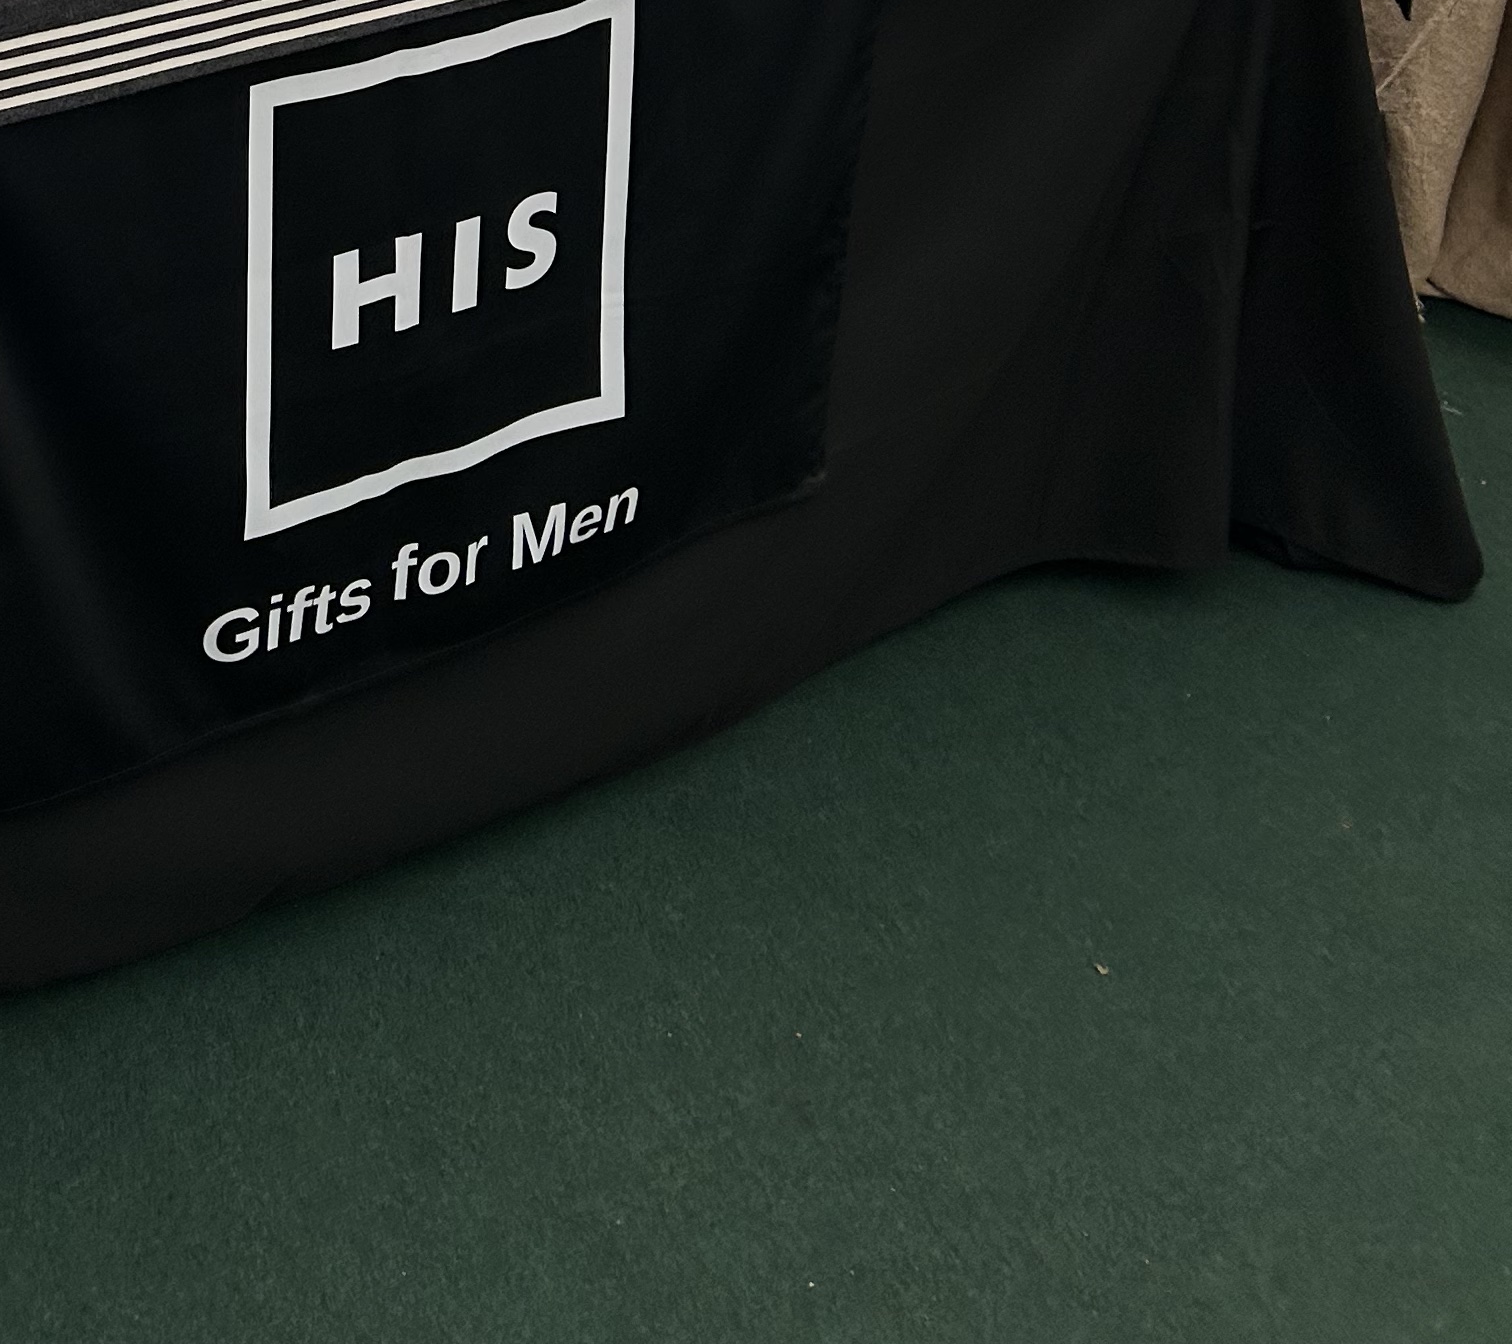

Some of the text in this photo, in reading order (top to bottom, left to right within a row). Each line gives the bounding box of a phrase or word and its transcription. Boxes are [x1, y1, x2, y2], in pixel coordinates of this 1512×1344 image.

[332, 191, 557, 350] HIS
[202, 487, 640, 664] Gifts for Men
